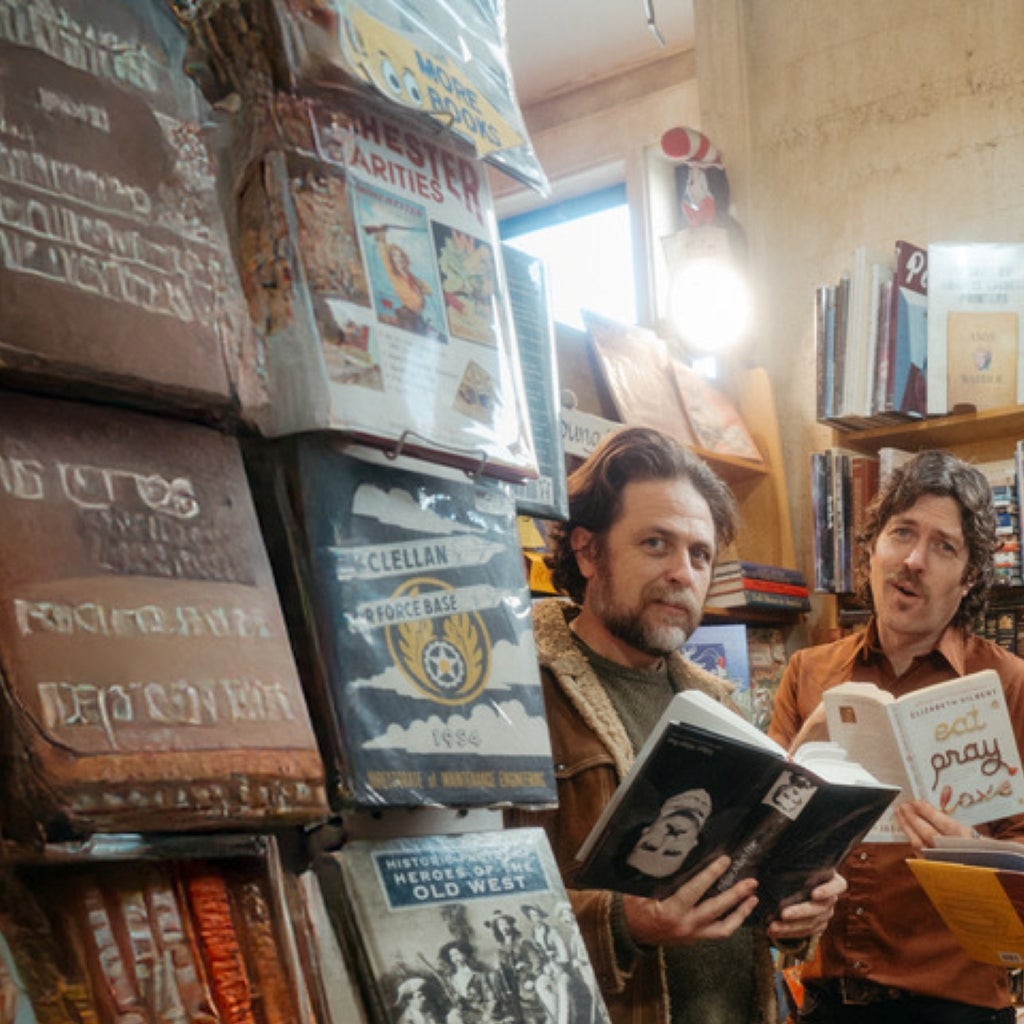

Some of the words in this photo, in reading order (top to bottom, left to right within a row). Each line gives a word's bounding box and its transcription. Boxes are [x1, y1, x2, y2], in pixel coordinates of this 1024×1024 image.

[414, 50, 480, 111] MORE
[427, 85, 502, 147] BOOKS
[348, 144, 445, 204] ARITIES
[353, 110, 485, 225] HESTER
[376, 600, 422, 625] FORCE
[423, 594, 458, 614] BASE
[933, 705, 988, 743] eat
[931, 737, 1011, 793] pray
[939, 779, 1015, 815] love
[393, 867, 468, 886] HEROES
[472, 865, 494, 878] OF
[412, 882, 461, 901] OLD
[466, 875, 528, 895] WEST
